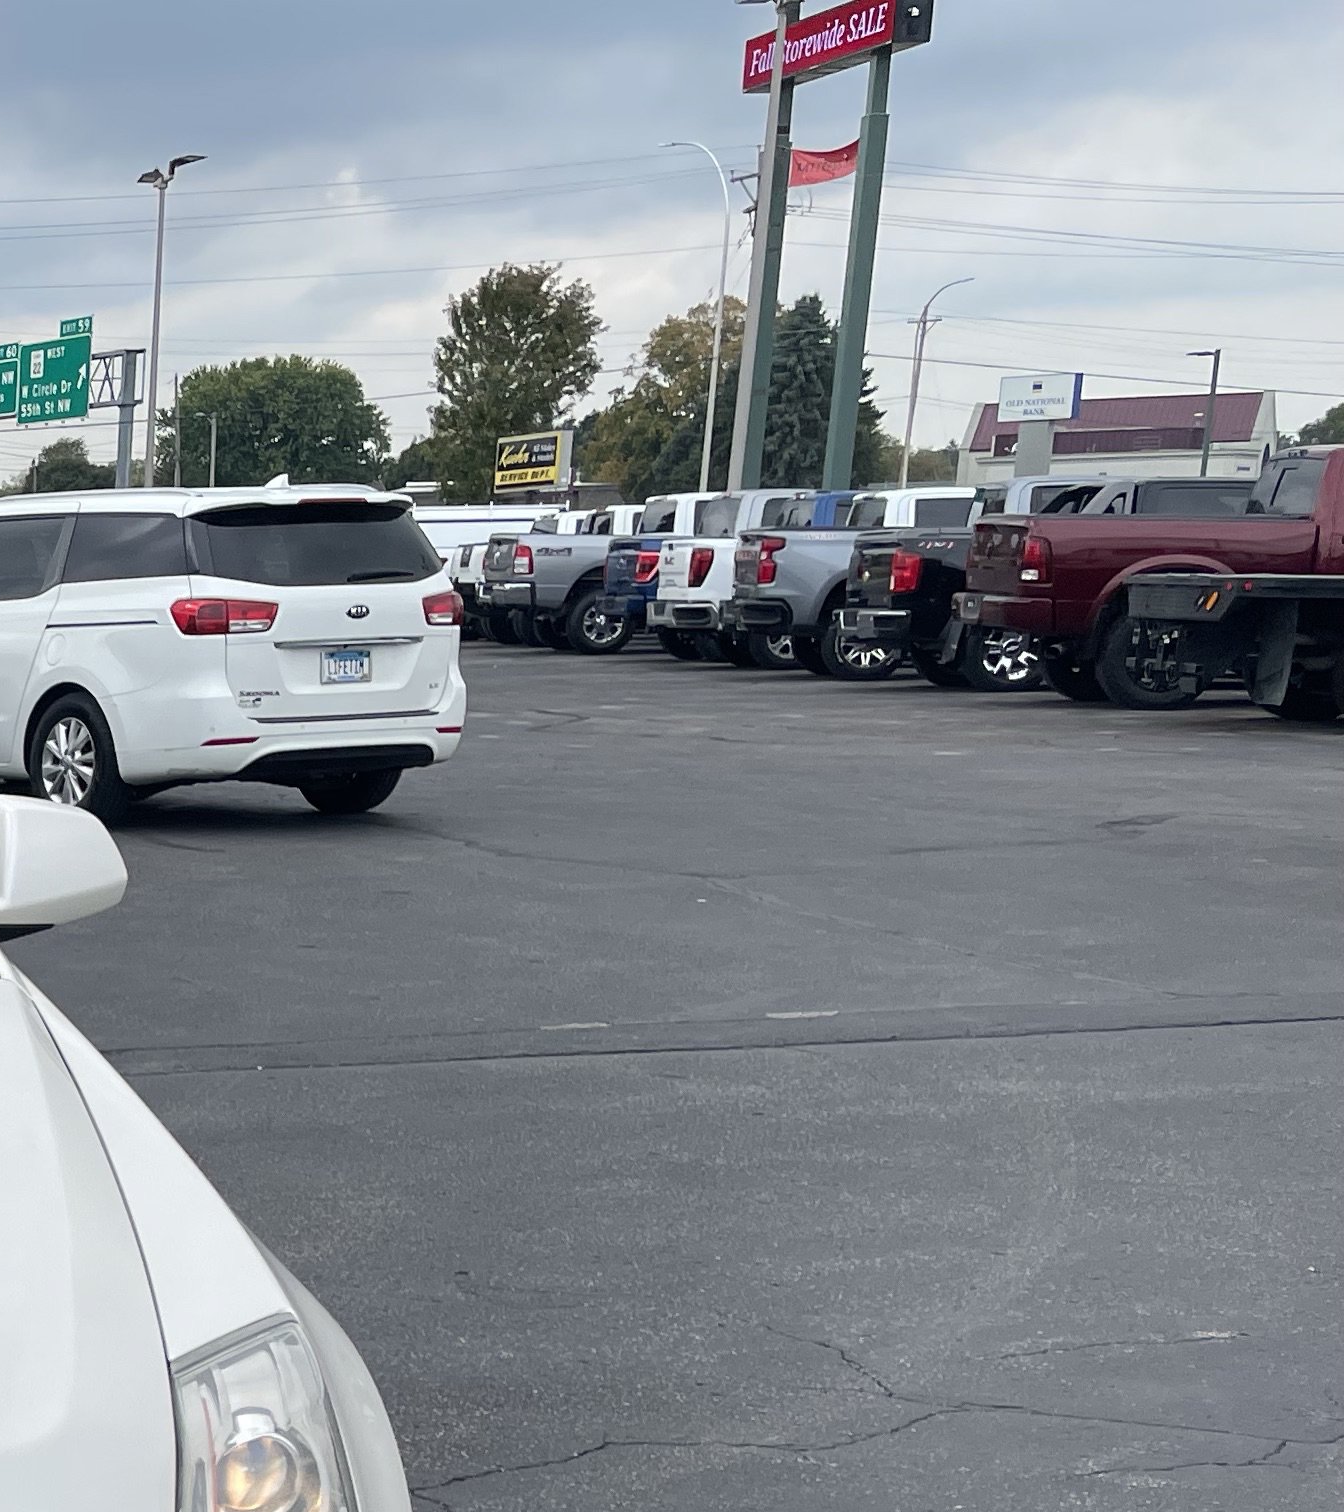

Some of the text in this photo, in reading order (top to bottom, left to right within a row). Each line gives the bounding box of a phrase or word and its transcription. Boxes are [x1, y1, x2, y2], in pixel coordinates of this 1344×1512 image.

[749, 43, 776, 77] Fall
[847, 2, 889, 43] SALE
[62, 318, 90, 334] EXIT 59
[5, 345, 17, 358] 60
[47, 346, 65, 359] WEST
[33, 362, 42, 375] 22
[1, 371, 14, 385] NW
[21, 380, 72, 399] W Circle Dr
[20, 399, 71, 417] 55th St NW
[1005, 396, 1066, 408] OLD NATIONAL
[1023, 407, 1045, 417] BANK
[500, 471, 529, 482] SERVICE
